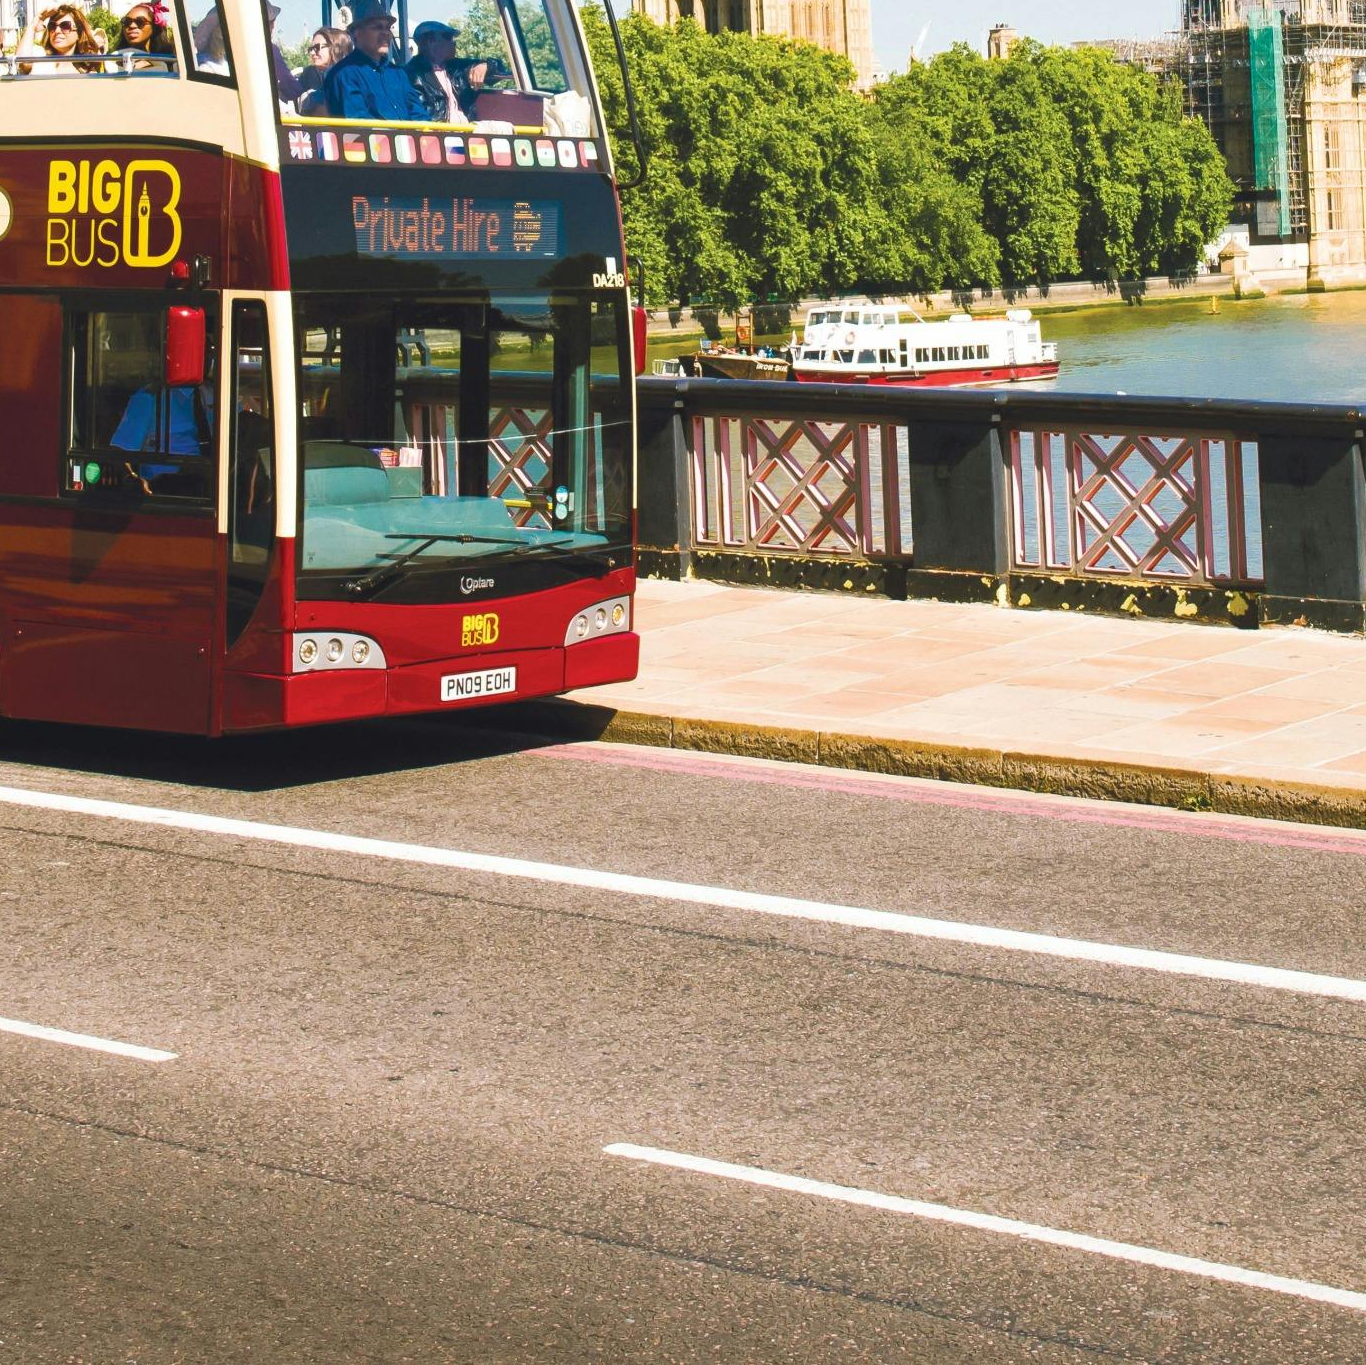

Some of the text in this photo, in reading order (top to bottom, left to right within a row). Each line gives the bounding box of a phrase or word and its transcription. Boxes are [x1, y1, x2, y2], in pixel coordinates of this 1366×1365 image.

[48, 160, 121, 213] BIG
[352, 196, 500, 252] Private Hire
[46, 219, 119, 267] BUS
[592, 273, 625, 287] DA218
[466, 576, 495, 592] Optare
[462, 615, 483, 632] BIG
[461, 630, 483, 647] BUS
[447, 671, 511, 697] PN09 EOH
